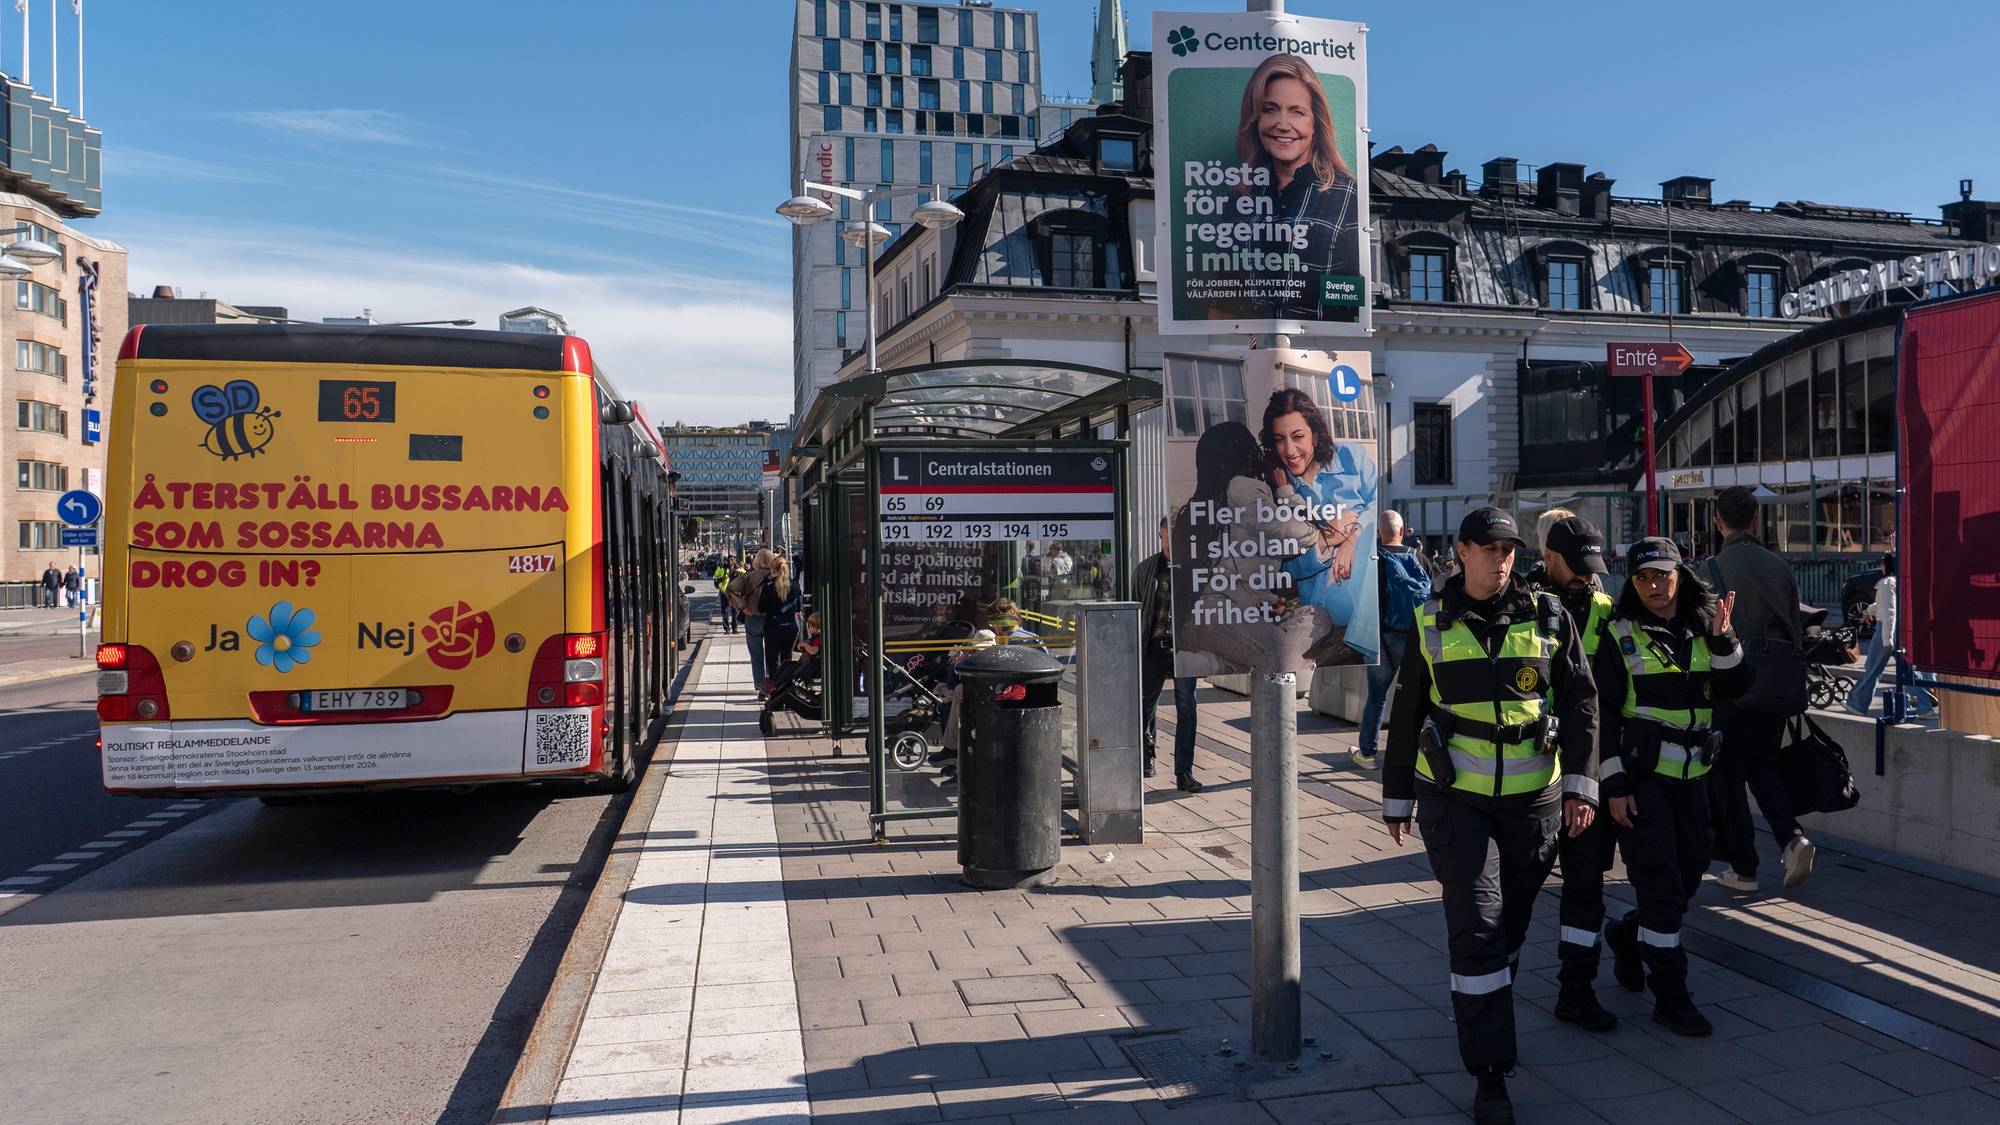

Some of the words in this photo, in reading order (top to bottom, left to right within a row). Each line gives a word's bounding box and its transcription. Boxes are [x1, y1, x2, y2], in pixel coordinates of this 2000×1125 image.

[1204, 32, 1356, 60] Centerpartiet
[1184, 160, 1270, 187] Rösta
[1184, 189, 1229, 215] för
[1236, 195, 1273, 215] en
[1185, 215, 1309, 250] regering
[1186, 246, 1193, 272] i
[1202, 244, 1309, 272] mitten.
[1186, 278, 1204, 288] FÖR
[1205, 279, 1243, 290] JOBBEN,
[1245, 279, 1286, 287] KLIMATET
[1287, 280, 1306, 288] OCH
[1186, 289, 1237, 299] VÄLFÄRDEN
[1243, 289, 1266, 298] HELA
[1268, 290, 1302, 298] LANDET.
[1325, 281, 1355, 292] Sverige
[1325, 291, 1340, 300] kan
[1341, 293, 1358, 301] mer.
[1616, 348, 1657, 366] Entré
[1336, 369, 1356, 395] L
[199, 385, 254, 419] SD
[344, 387, 380, 419] 65
[893, 456, 908, 480] L
[928, 461, 1052, 476] Centralstationen
[133, 473, 358, 510] ÅTERSTÄLL
[371, 483, 569, 512] BUSSARNA
[887, 497, 906, 511] 65
[925, 496, 944, 511] 69
[1189, 500, 1247, 525] Fler
[1256, 496, 1347, 523] böcker
[132, 521, 224, 548] SOM
[237, 521, 444, 548] SOSSARNA
[884, 525, 910, 539] 191
[926, 525, 953, 538] 192
[965, 524, 991, 538] 193
[1003, 524, 1030, 538] 194
[1042, 523, 1068, 537] 195
[1190, 535, 1197, 559] i
[1207, 531, 1307, 558] skolan.
[509, 554, 555, 573] 4817
[894, 553, 911, 566] se
[914, 552, 983, 570] poängen
[131, 560, 246, 588] DROG
[259, 560, 321, 588] IN?
[900, 571, 922, 585] att
[926, 571, 982, 587] minska
[1192, 568, 1242, 592] För
[1248, 564, 1292, 590] din
[1191, 599, 1282, 626] frihet.
[204, 623, 240, 652] Ja
[358, 621, 415, 656] Nej
[319, 691, 356, 709] EHY
[363, 690, 399, 708] 789
[107, 741, 155, 751] POLITISKT
[158, 736, 271, 749] REKLAMMEDDELANDE
[140, 751, 224, 763] Sverigedemokraterna
[226, 749, 268, 758] Stockholm
[108, 764, 129, 772] Denna
[130, 762, 165, 772] kampanj
[189, 760, 200, 768] del
[215, 756, 301, 769] Sverigedemokraternas
[302, 753, 346, 763] valkampanj
[347, 752, 365, 761] inför
[366, 752, 377, 760] de
[378, 751, 412, 759] allmänna
[177, 770, 202, 779] region
[221, 768, 250, 777] riksdag
[256, 766, 285, 775] Sverige
[286, 765, 301, 773] den
[313, 763, 355, 773] september
